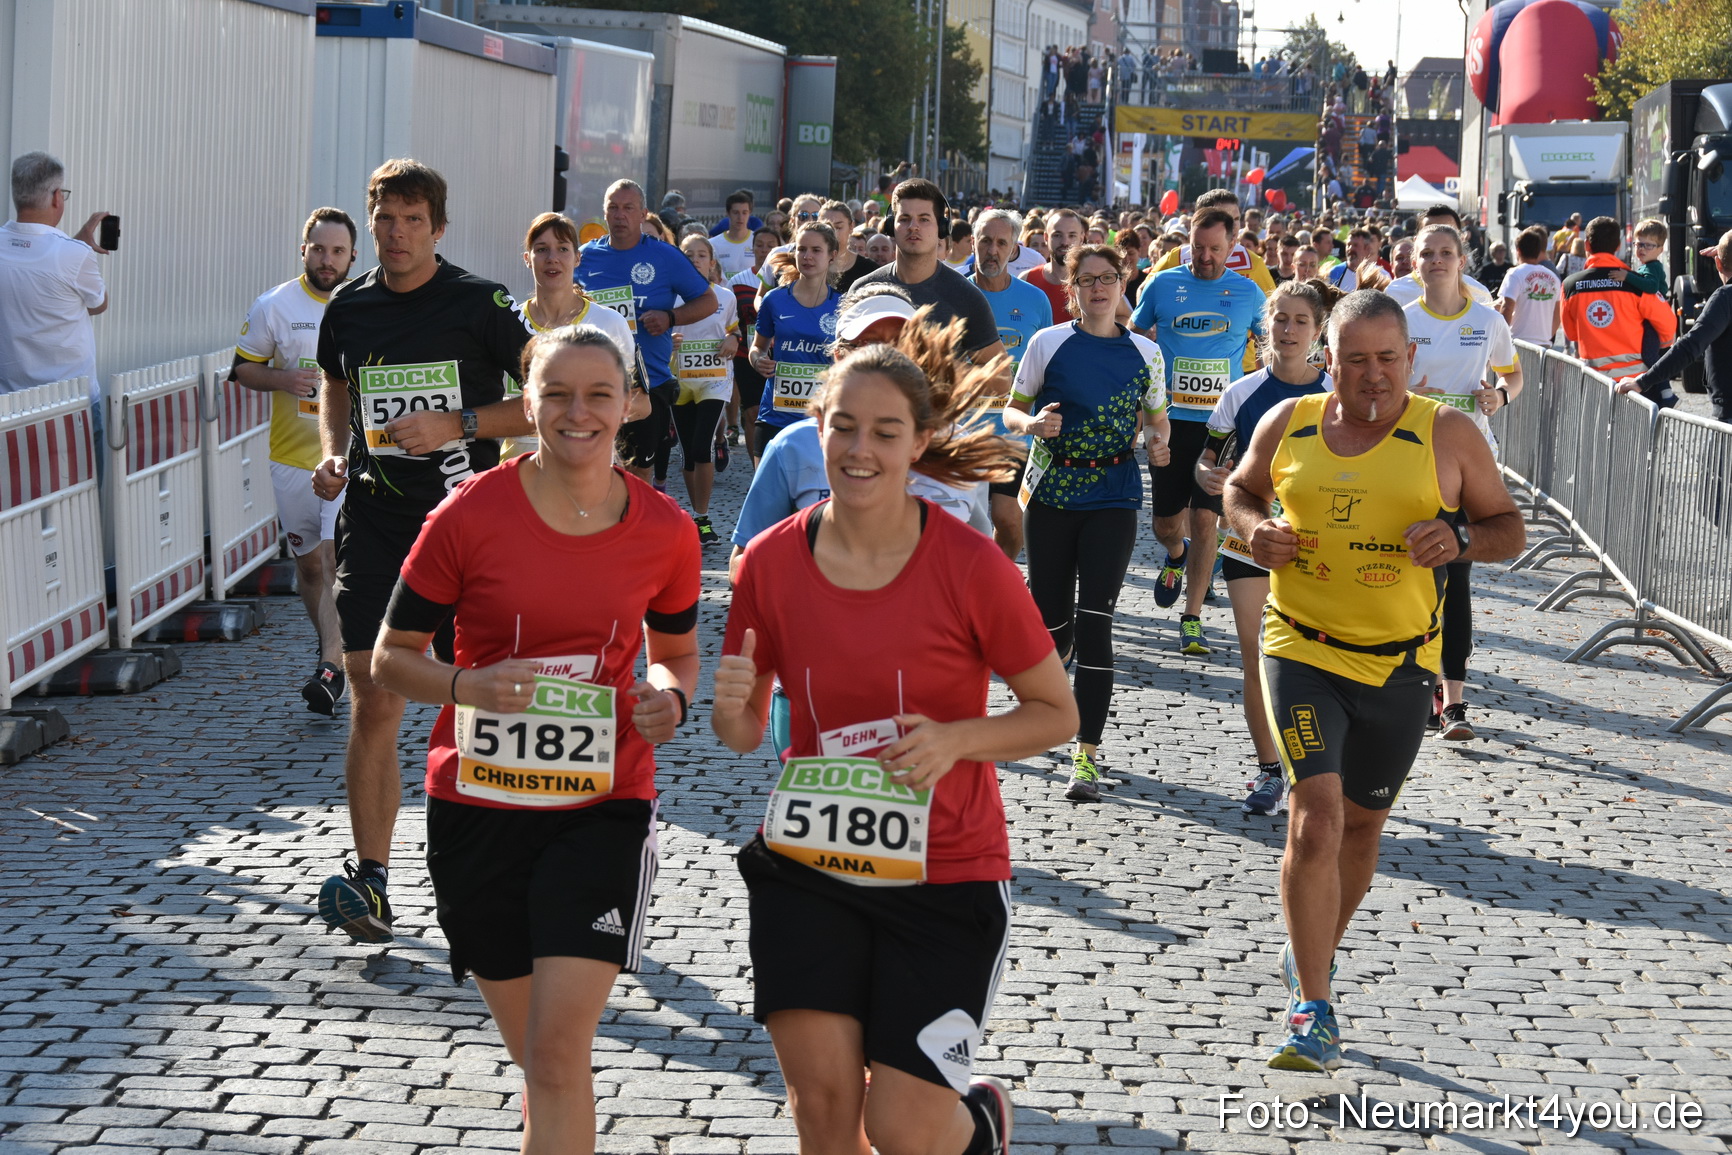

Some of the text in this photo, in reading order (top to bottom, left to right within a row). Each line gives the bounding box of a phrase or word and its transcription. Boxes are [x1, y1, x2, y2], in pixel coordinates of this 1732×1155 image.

[1182, 114, 1251, 133] START
[1541, 152, 1595, 162] BOCK
[1173, 317, 1229, 333] LAUF10!
[1460, 327, 1472, 336] 20
[781, 339, 826, 354] #LÄUF
[684, 353, 721, 368] 5286
[1178, 360, 1225, 373] BOCK
[367, 366, 450, 390] BOCK
[1178, 375, 1223, 393] 5094
[780, 380, 822, 396] 507
[1182, 395, 1218, 404] LOTHAR
[1318, 486, 1367, 495] FONDSZENTRUM
[1326, 522, 1360, 531] NEUMARKT
[1296, 533, 1318, 549] Seidl
[1356, 563, 1401, 575] PIZZERIA
[1363, 572, 1396, 582] ELIO
[1296, 709, 1321, 747] Run!
[473, 717, 595, 763] 5182
[842, 728, 878, 748] DEHN
[1288, 728, 1303, 758] Team
[473, 765, 597, 792] CHRISTINA
[783, 798, 909, 851] 5180
[813, 855, 877, 875] JANA
[592, 921, 626, 937] adidas
